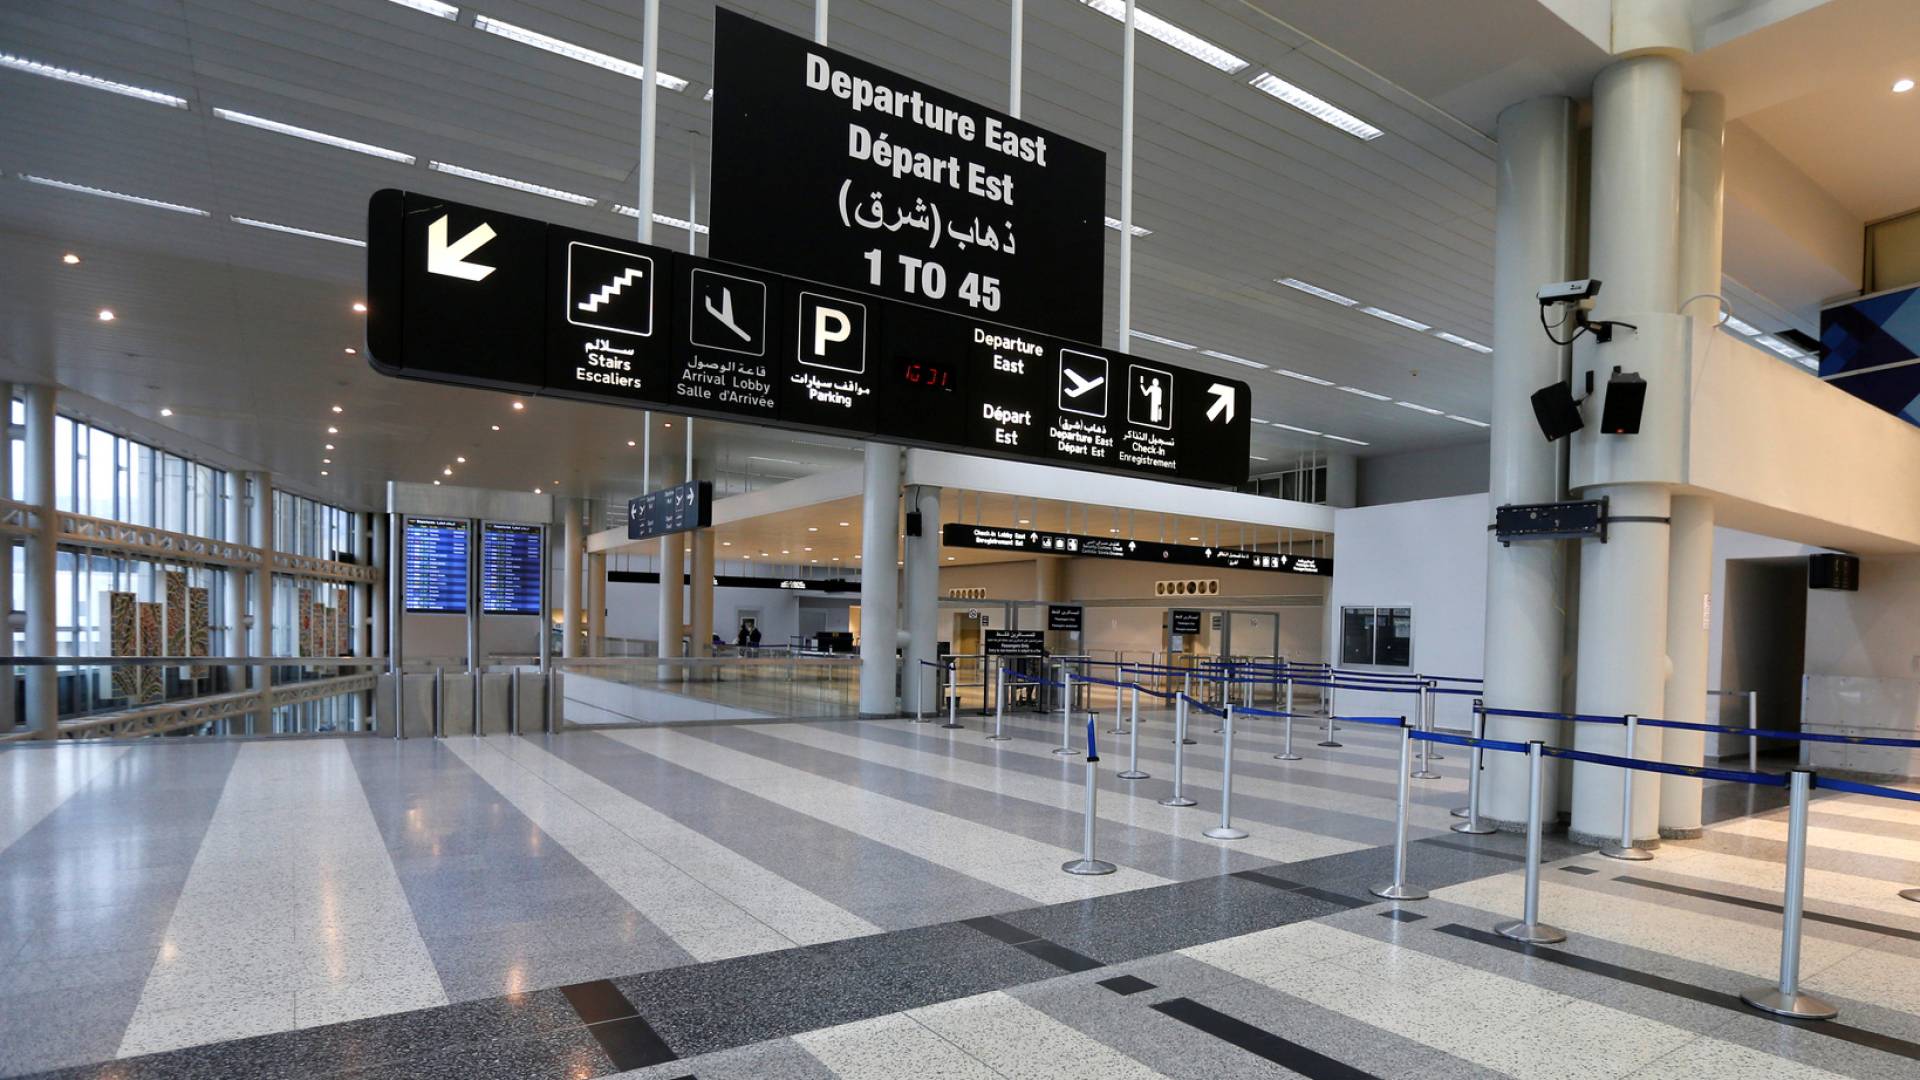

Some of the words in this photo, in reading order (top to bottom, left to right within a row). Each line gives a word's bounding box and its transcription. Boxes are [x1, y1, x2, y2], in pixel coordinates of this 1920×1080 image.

[806, 52, 975, 141] Departure
[985, 116, 1046, 167] East
[849, 123, 960, 189] Départ
[968, 162, 1014, 205] Est
[838, 179, 941, 249] (شرق)
[948, 216, 1015, 254] ذهاب
[864, 248, 881, 286] 1
[899, 254, 946, 299] TO
[958, 272, 1001, 312] 45
[974, 328, 1043, 356] Departure
[588, 353, 631, 370] Stairs
[688, 355, 735, 374] الوصول
[738, 363, 766, 377] قاعة
[993, 354, 1024, 374] East
[576, 367, 641, 388] Escaliers
[682, 369, 725, 386] Arrival
[733, 376, 770, 395] Lobby
[676, 384, 711, 398] Salle
[719, 390, 774, 408] d'Arrivée
[809, 388, 852, 407] Parking
[983, 403, 1031, 425] Départ
[995, 428, 1018, 445] Est
[1050, 427, 1092, 444] Departure
[1095, 435, 1113, 447] East
[1091, 446, 1105, 457] Est
[1119, 451, 1176, 470] Enregistrement
